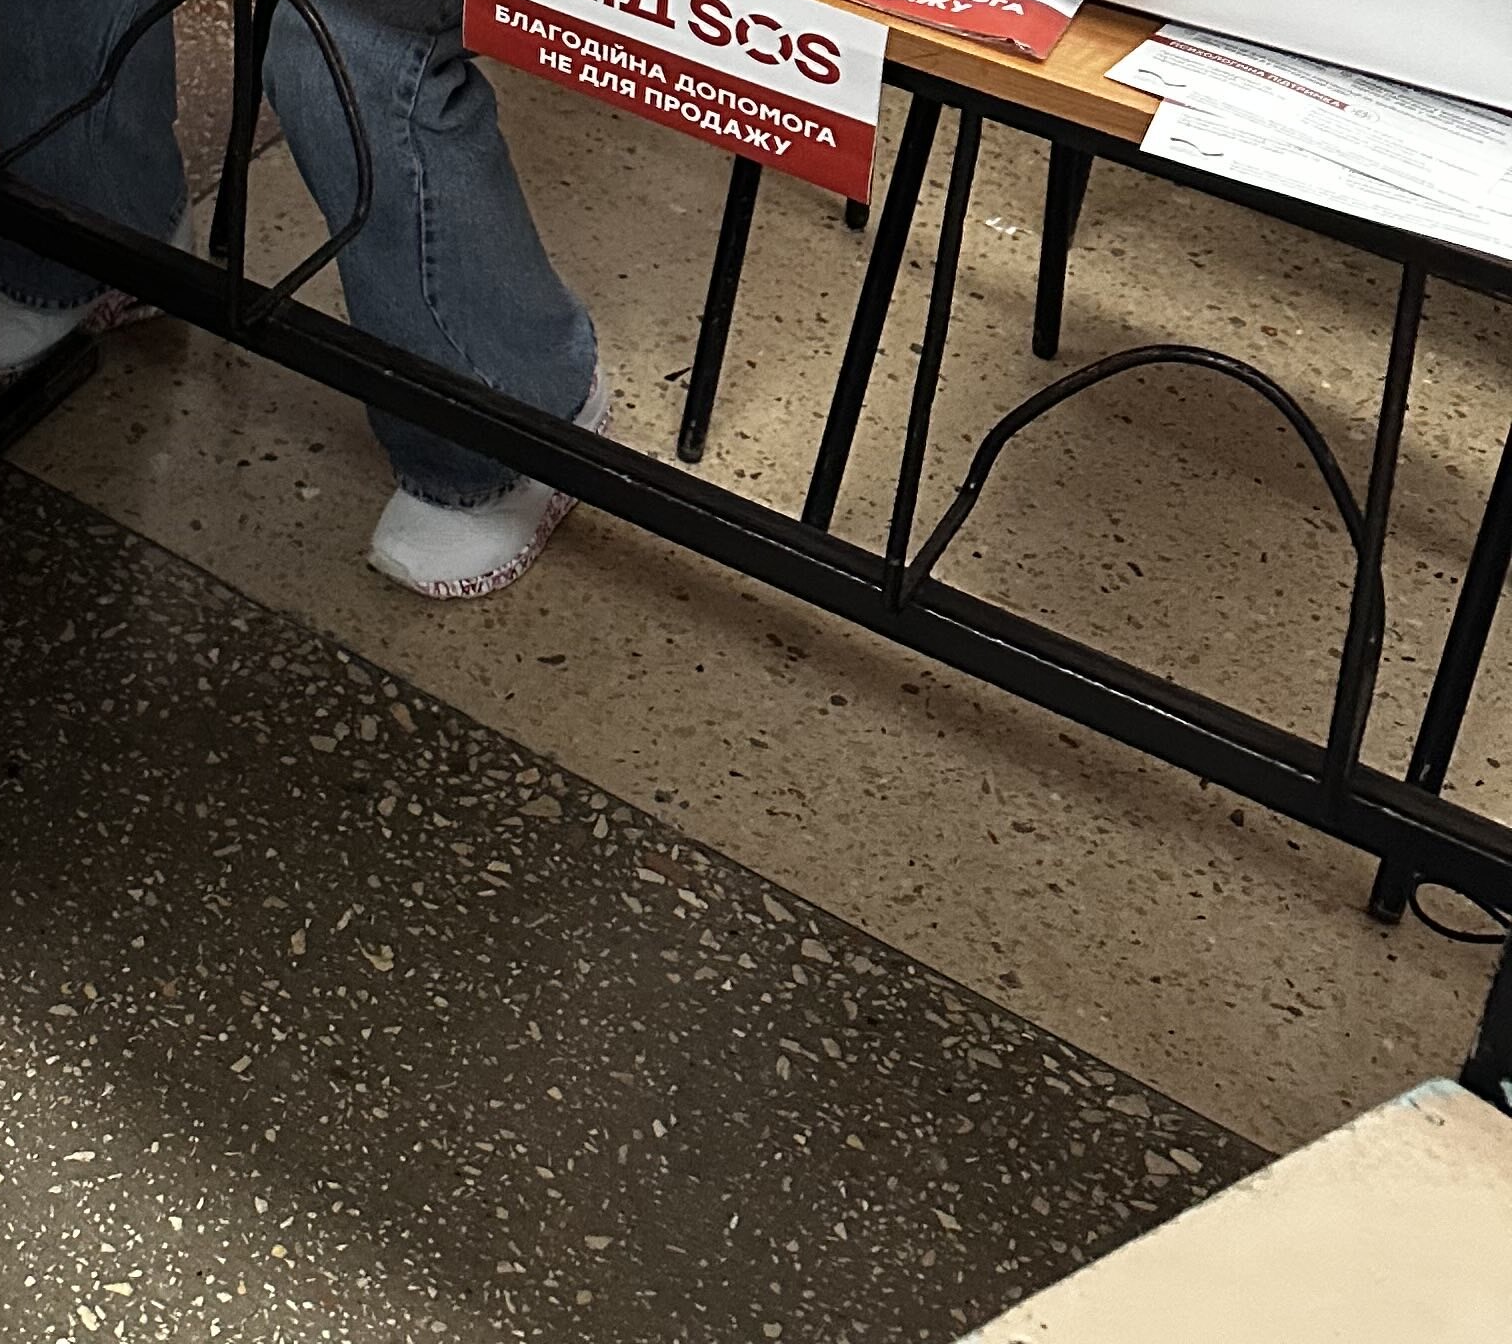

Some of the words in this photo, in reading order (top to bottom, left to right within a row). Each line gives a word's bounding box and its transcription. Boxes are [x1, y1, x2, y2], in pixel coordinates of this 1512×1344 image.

[493, 3, 666, 84] БЛАГОДІЙНА
[675, 58, 838, 150] ДОПОМОГА
[538, 47, 575, 74] НЕ
[578, 61, 638, 100] ДЛЯ
[644, 84, 792, 158] ПРОДАЖУ
